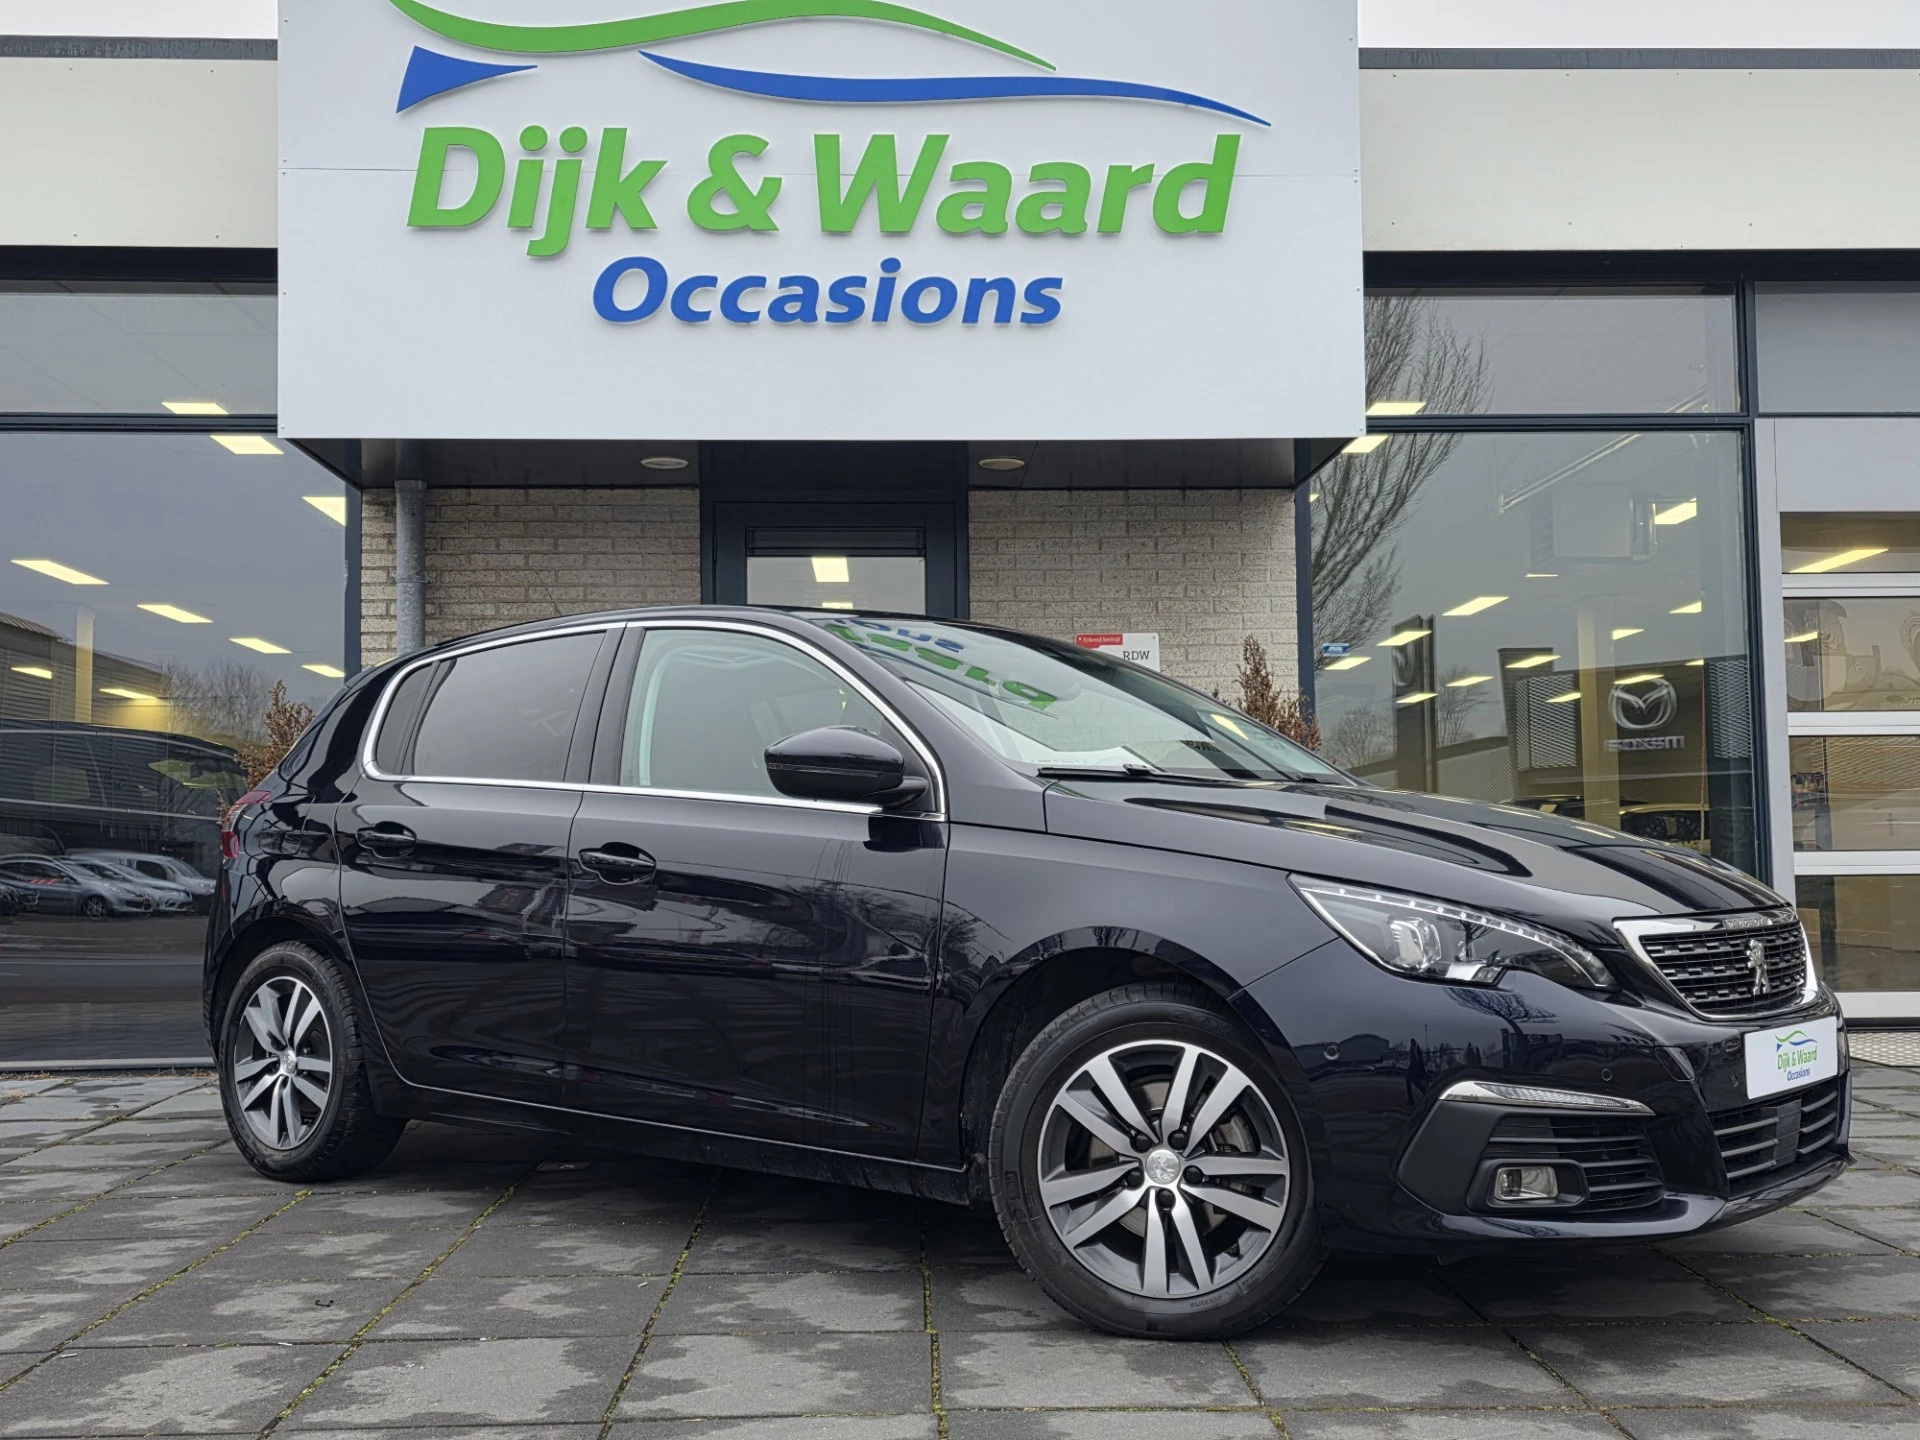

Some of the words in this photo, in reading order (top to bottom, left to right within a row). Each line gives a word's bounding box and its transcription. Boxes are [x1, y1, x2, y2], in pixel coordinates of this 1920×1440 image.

[407, 125, 668, 257] Dijk
[687, 134, 783, 232] &
[814, 134, 1241, 234] Waard
[593, 256, 1063, 324] Occasions
[1123, 650, 1150, 661] RDW
[1777, 1052, 1791, 1072] Dijk
[1791, 1051, 1797, 1066] &
[1797, 1045, 1818, 1065] Waard
[1787, 1067, 1811, 1081] Occasions
